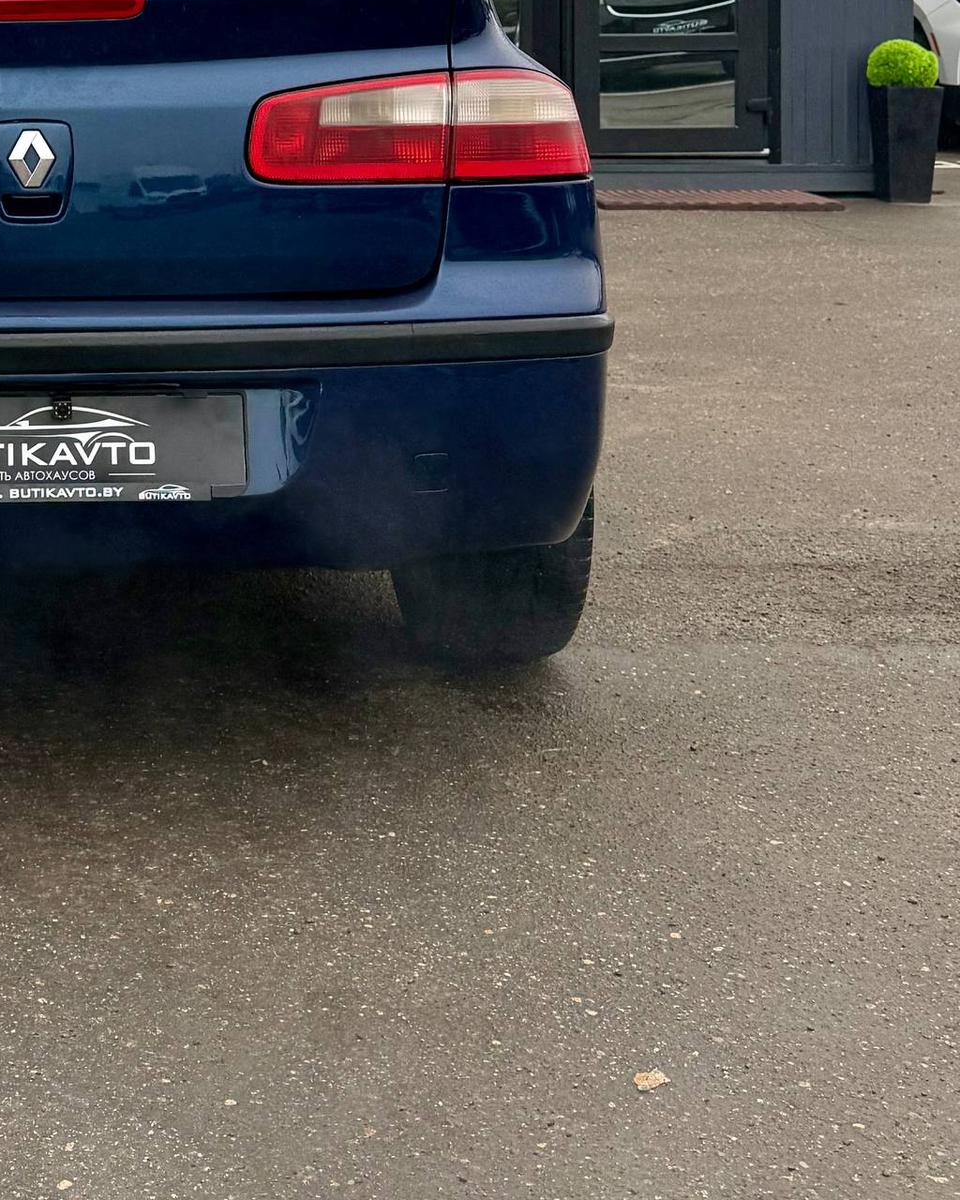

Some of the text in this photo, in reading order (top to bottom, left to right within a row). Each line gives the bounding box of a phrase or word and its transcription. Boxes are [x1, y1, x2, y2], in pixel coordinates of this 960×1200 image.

[15, 469, 96, 481] АВТОХАУСОВ
[9, 486, 124, 499] BUTIKAVTO.BY
[138, 491, 192, 500] BUTIKAVTO
